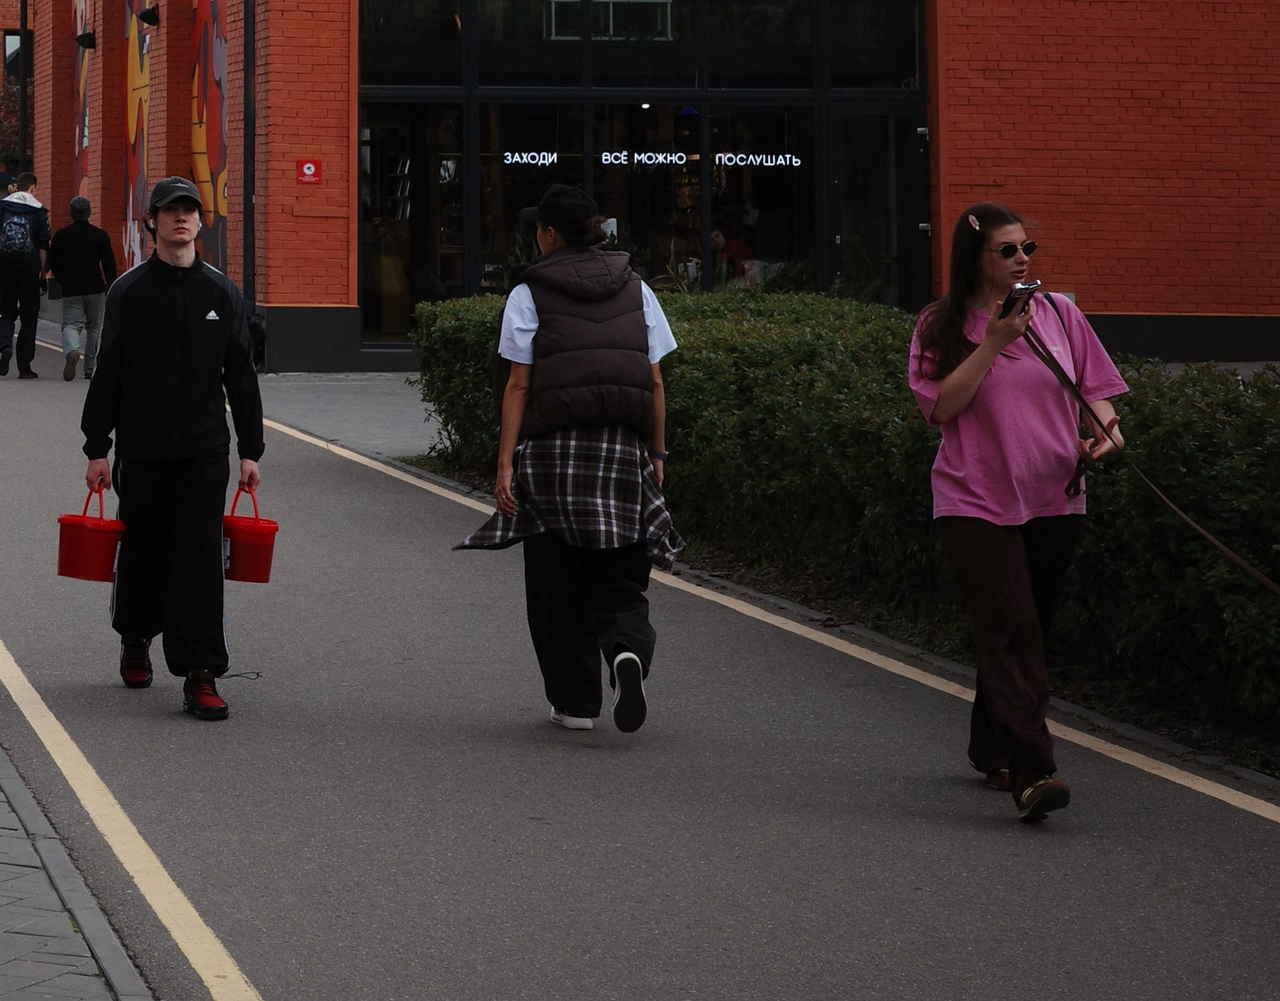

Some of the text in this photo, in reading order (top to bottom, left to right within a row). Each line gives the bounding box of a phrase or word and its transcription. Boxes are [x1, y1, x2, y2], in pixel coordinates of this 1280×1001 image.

[503, 150, 801, 167] ЗАХОДИ ВСЁ МОЖНО ПОСЛУШАТЬ
